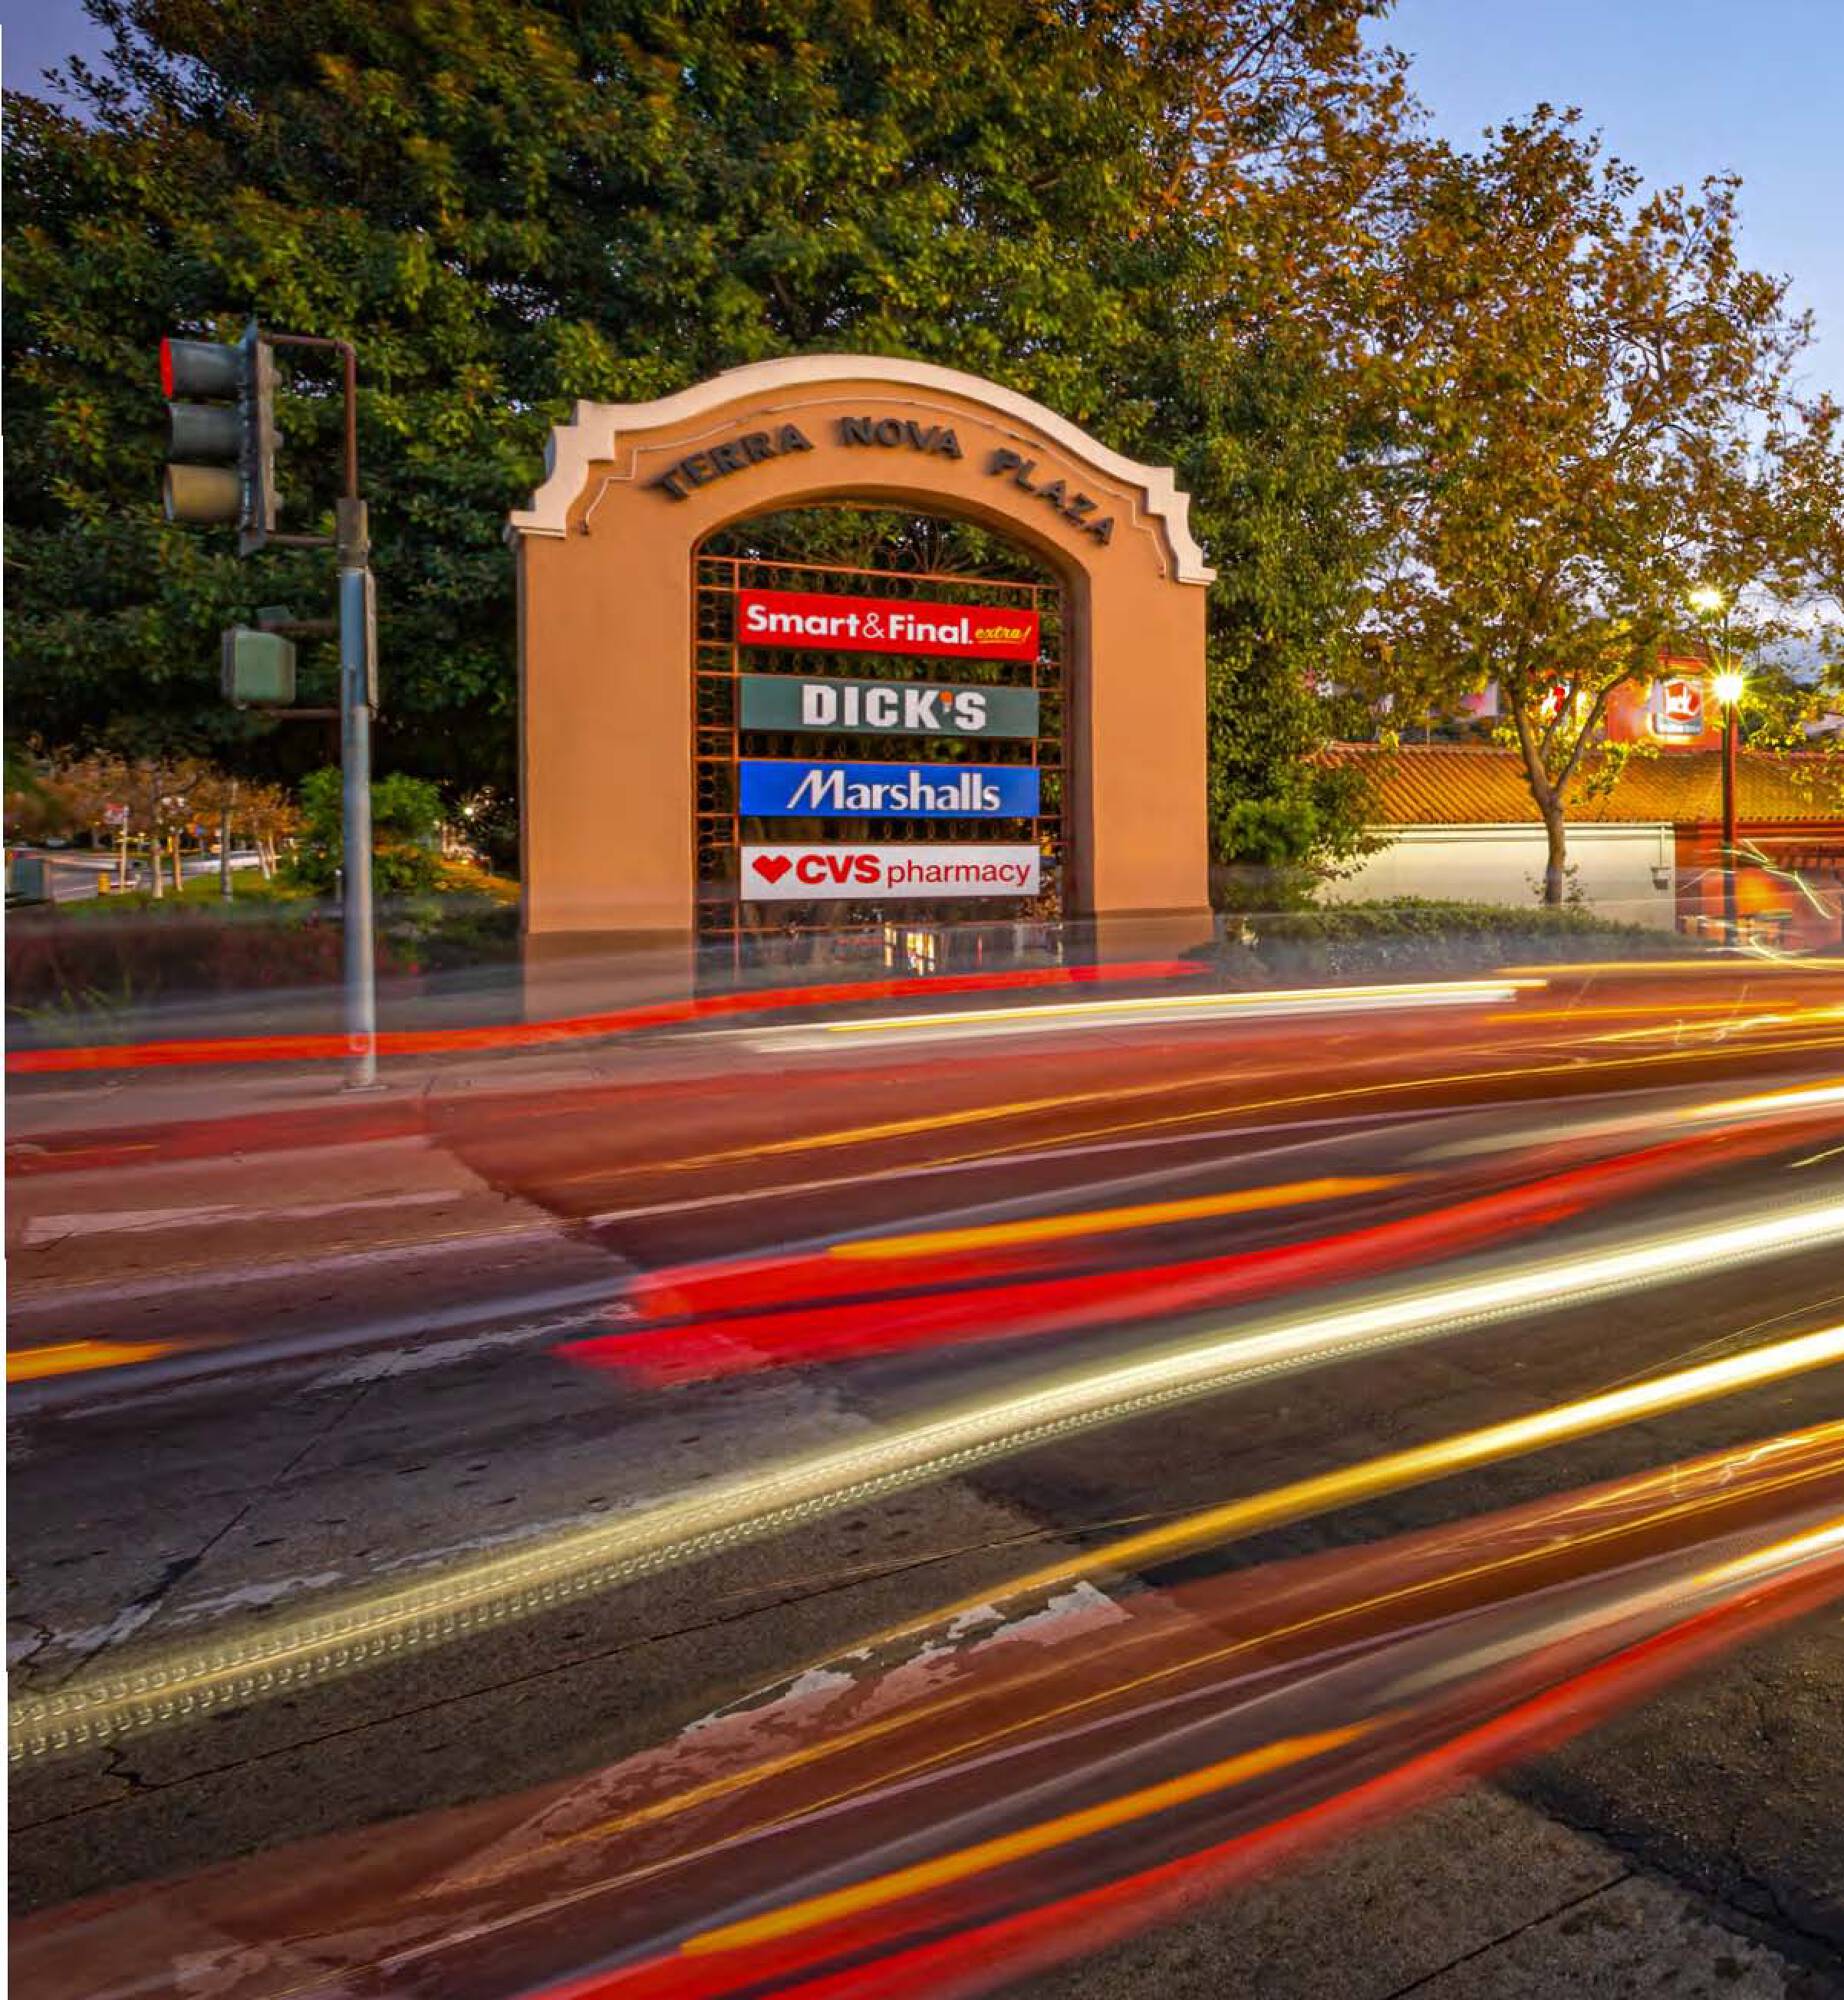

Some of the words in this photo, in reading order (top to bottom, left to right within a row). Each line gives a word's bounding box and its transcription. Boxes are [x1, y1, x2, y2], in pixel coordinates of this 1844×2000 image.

[647, 422, 815, 501] TERRA
[836, 416, 963, 459] NOVA
[986, 448, 1115, 546] PLAZA
[974, 625, 1032, 643] extra!
[802, 684, 987, 731] DICK'S
[786, 769, 1001, 811] Marshalls
[796, 854, 881, 885] CVS
[887, 859, 1031, 888] pharmacy
